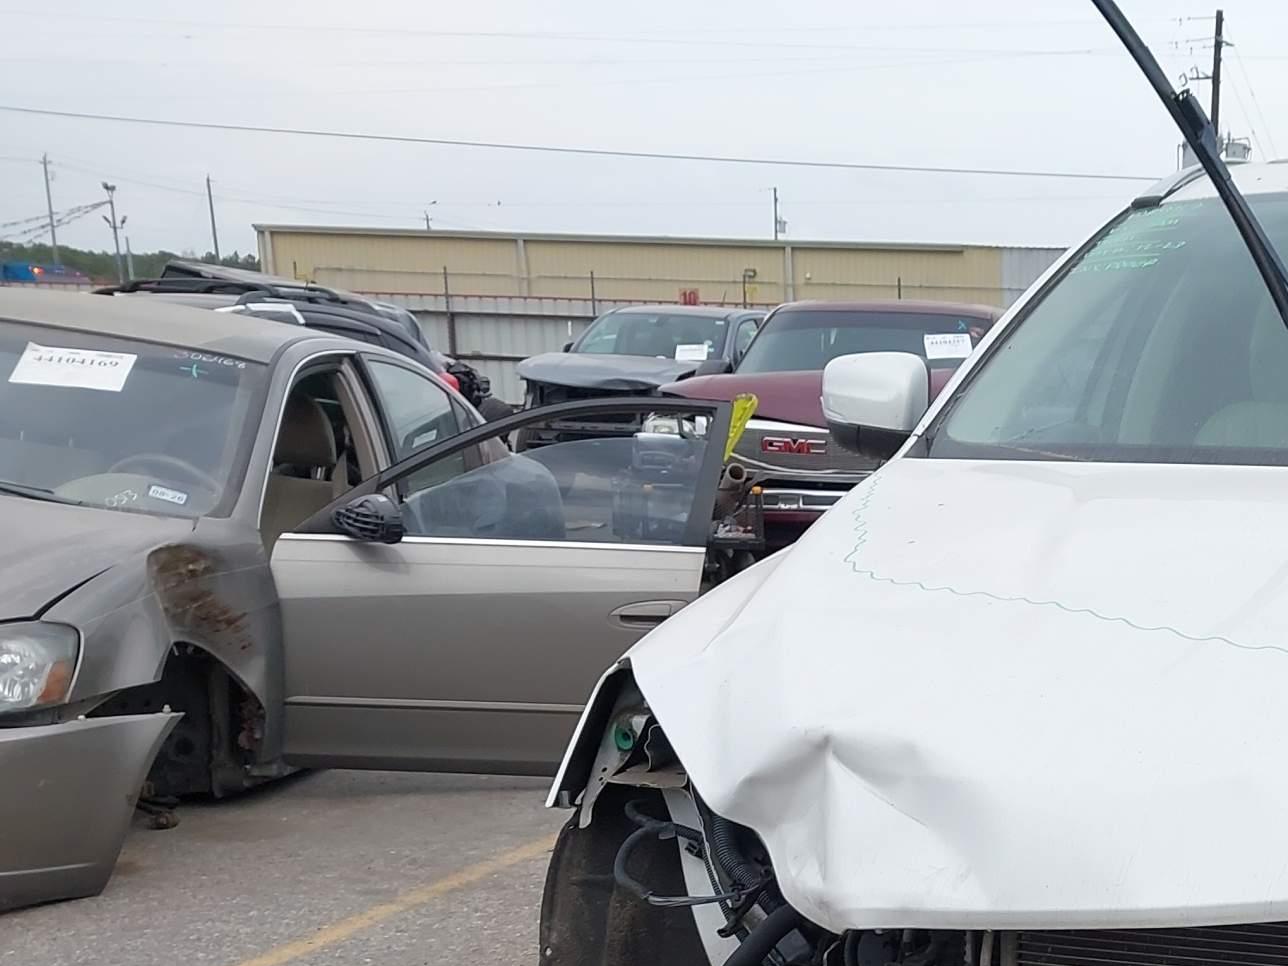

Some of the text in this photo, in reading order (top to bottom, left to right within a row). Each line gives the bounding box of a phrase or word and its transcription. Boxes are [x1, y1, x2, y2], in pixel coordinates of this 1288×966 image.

[680, 290, 698, 306] 10
[33, 354, 120, 368] 44104169
[761, 435, 827, 455] GMC
